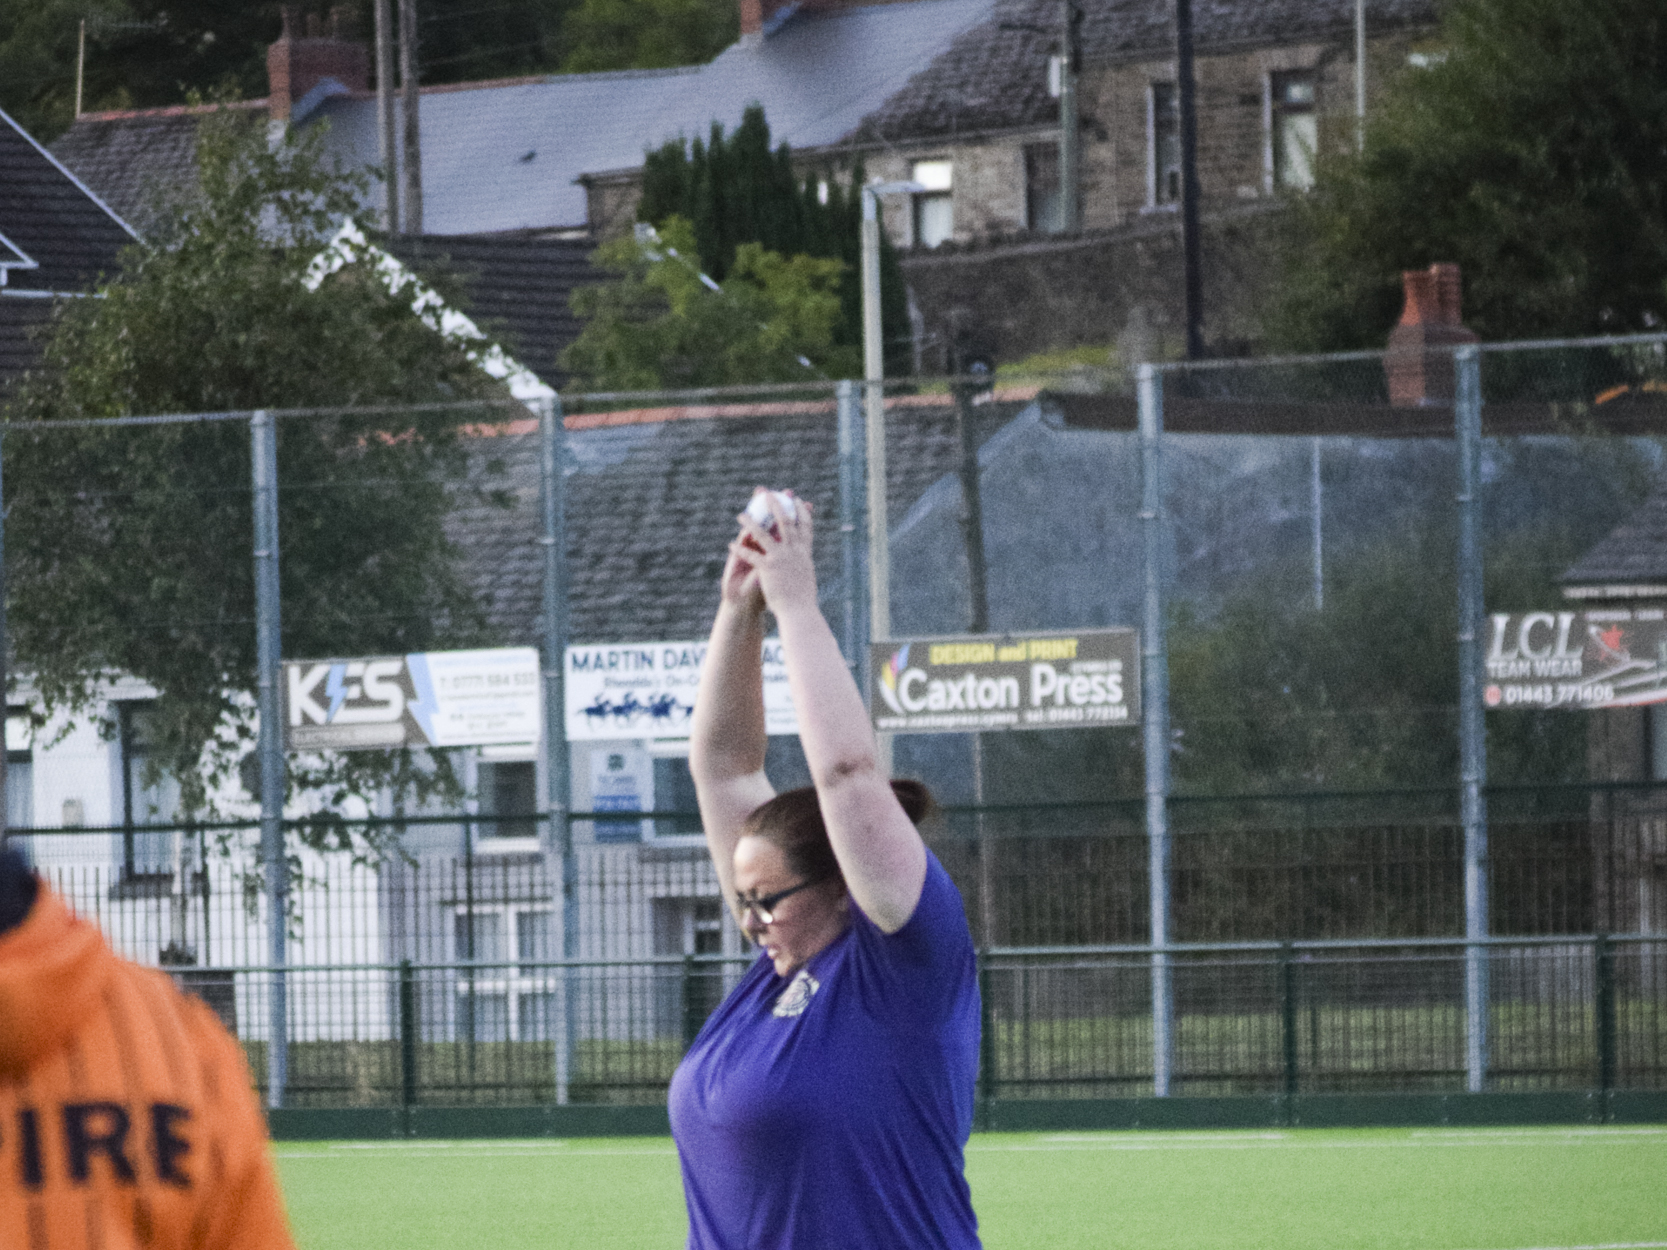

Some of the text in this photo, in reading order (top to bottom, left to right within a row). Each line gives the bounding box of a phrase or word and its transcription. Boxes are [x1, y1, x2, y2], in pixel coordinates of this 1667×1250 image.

[1488, 612, 1583, 660] LCL
[572, 650, 655, 671] MARTIN
[930, 639, 1078, 665] DESIGN and PRINT
[1487, 659, 1582, 678] TEAM WEAR
[289, 661, 404, 726] KES
[898, 662, 1123, 712] Caxton Press
[1503, 684, 1553, 705] 01443
